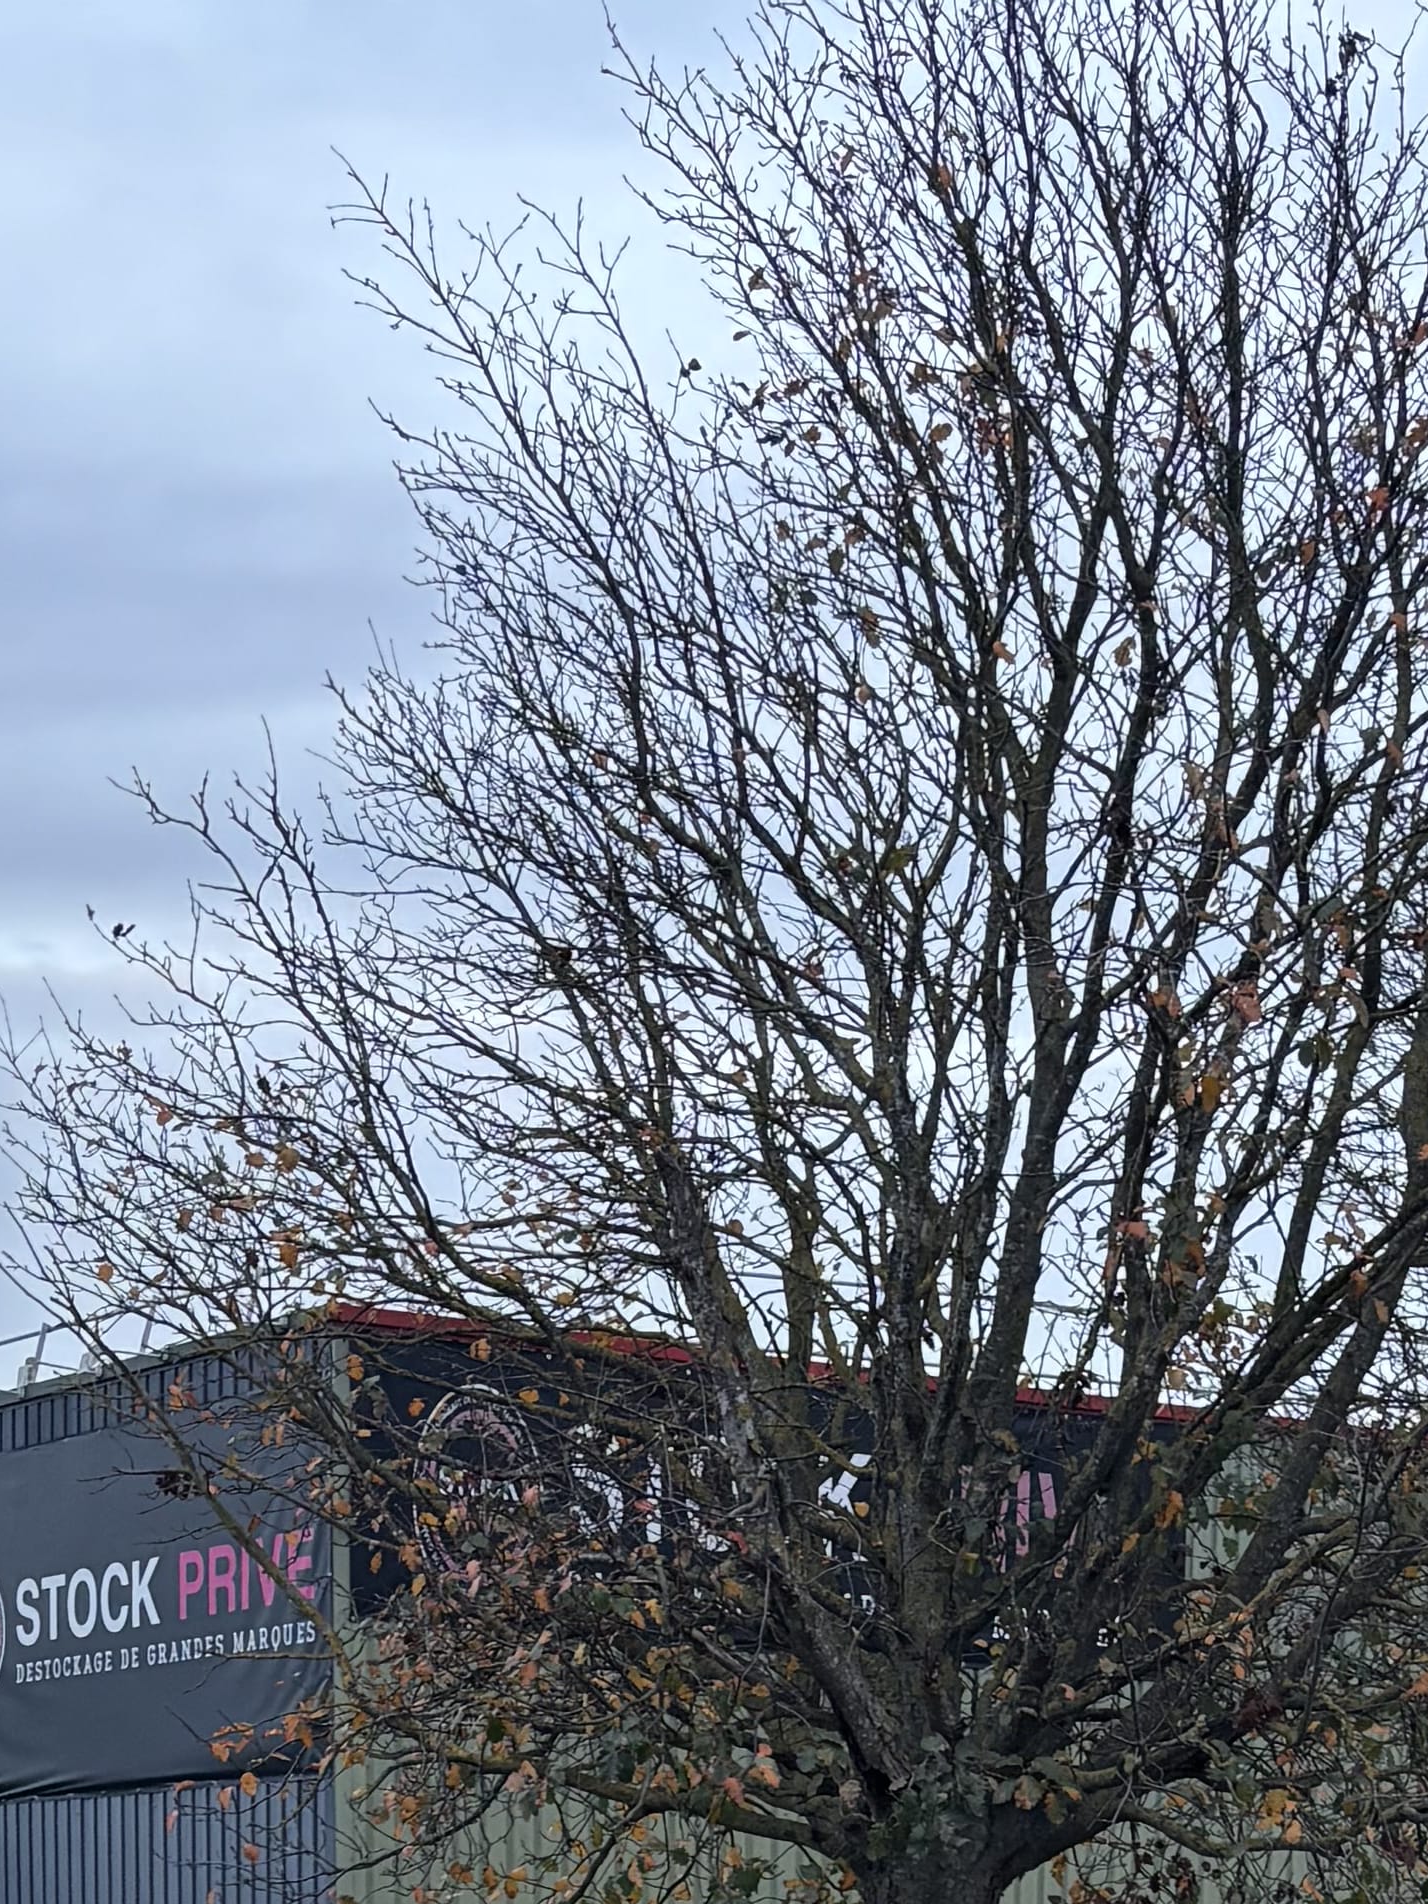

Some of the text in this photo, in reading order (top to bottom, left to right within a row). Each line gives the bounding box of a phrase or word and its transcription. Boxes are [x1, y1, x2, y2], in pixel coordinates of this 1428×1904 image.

[16, 1556, 161, 1647] STOCK
[16, 1621, 316, 1684] DESTOCKAGE DE GRANDES MARQUES
